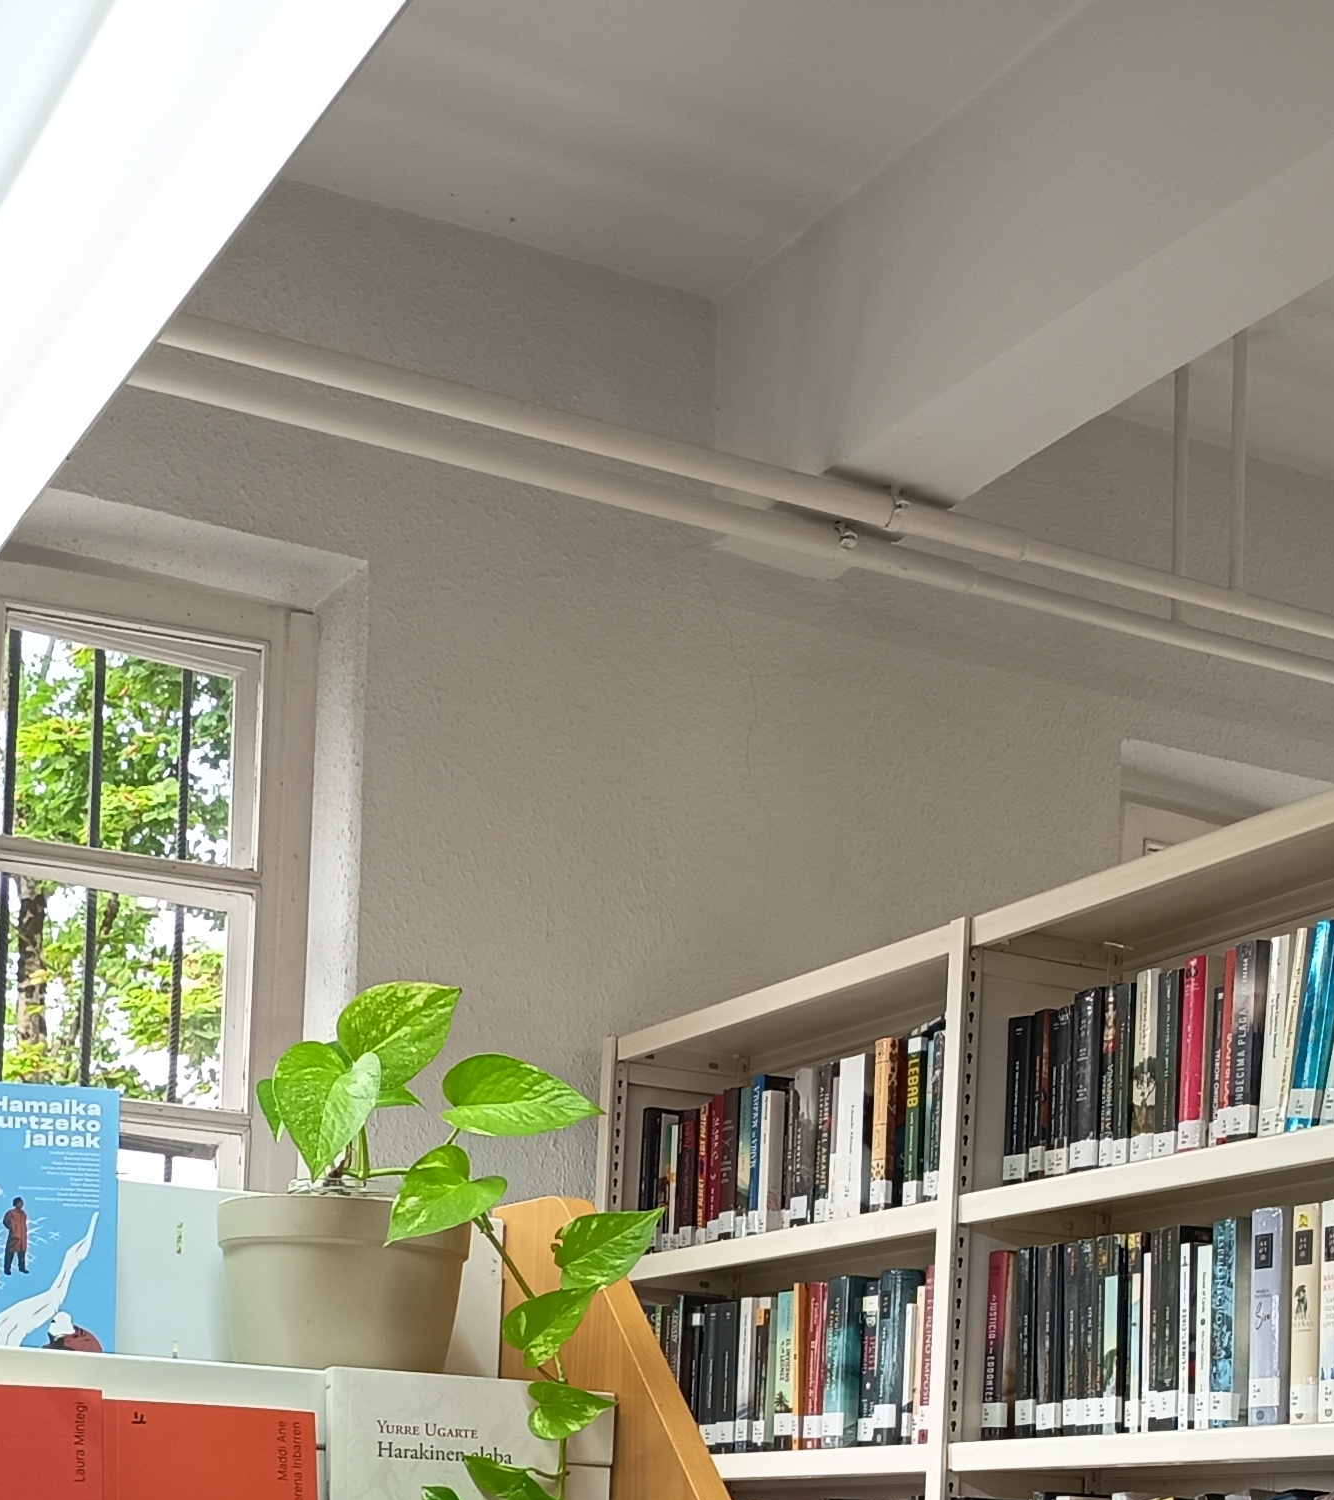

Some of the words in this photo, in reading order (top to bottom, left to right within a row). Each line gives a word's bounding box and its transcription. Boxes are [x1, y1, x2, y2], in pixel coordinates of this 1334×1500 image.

[24, 1130, 100, 1149] jaioak
[74, 1401, 88, 1447] Mintegi
[377, 1420, 419, 1436] YURRE
[425, 1423, 478, 1439] UGARTE
[377, 1441, 465, 1461] Harakinen
[74, 1451, 86, 1483] Laura
